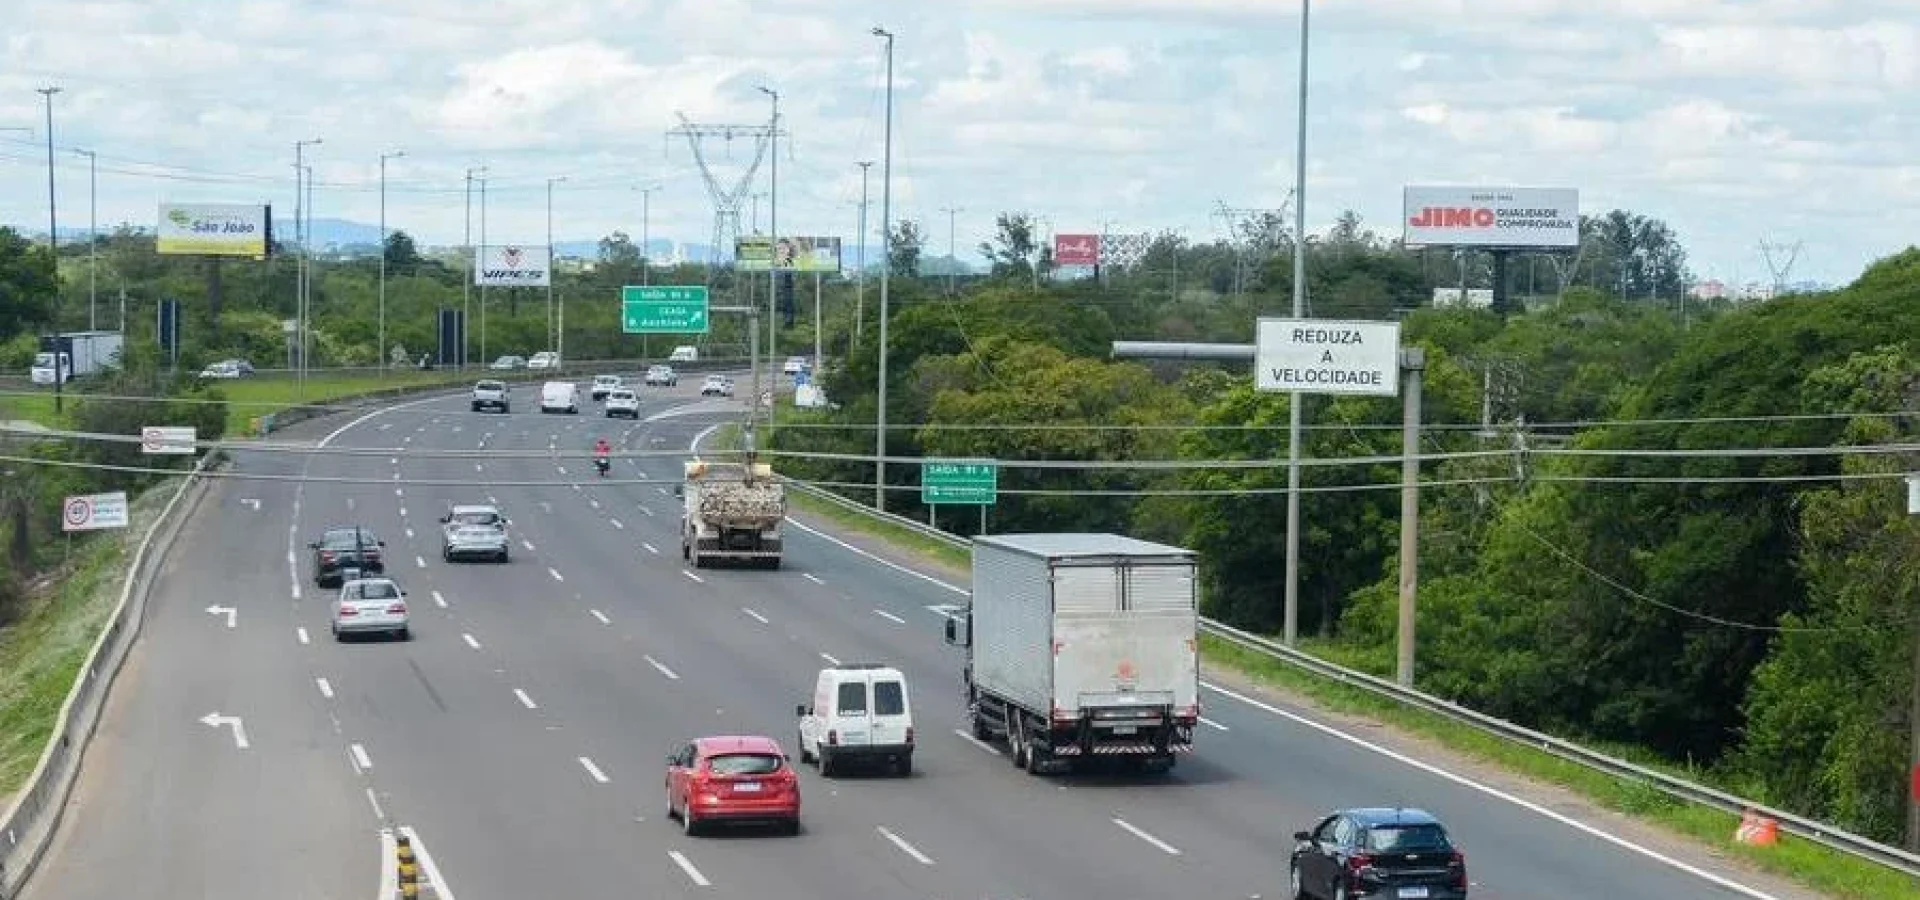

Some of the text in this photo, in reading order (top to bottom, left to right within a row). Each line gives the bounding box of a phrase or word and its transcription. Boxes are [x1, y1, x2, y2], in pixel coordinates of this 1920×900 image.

[1409, 207, 1495, 227] JIMO
[1496, 208, 1558, 218] QUALIDADE
[1496, 219, 1574, 229] COMPROVADA
[1292, 327, 1364, 344] REDUZA
[1320, 348, 1334, 362] A
[1271, 368, 1383, 385] VELOCIDADE
